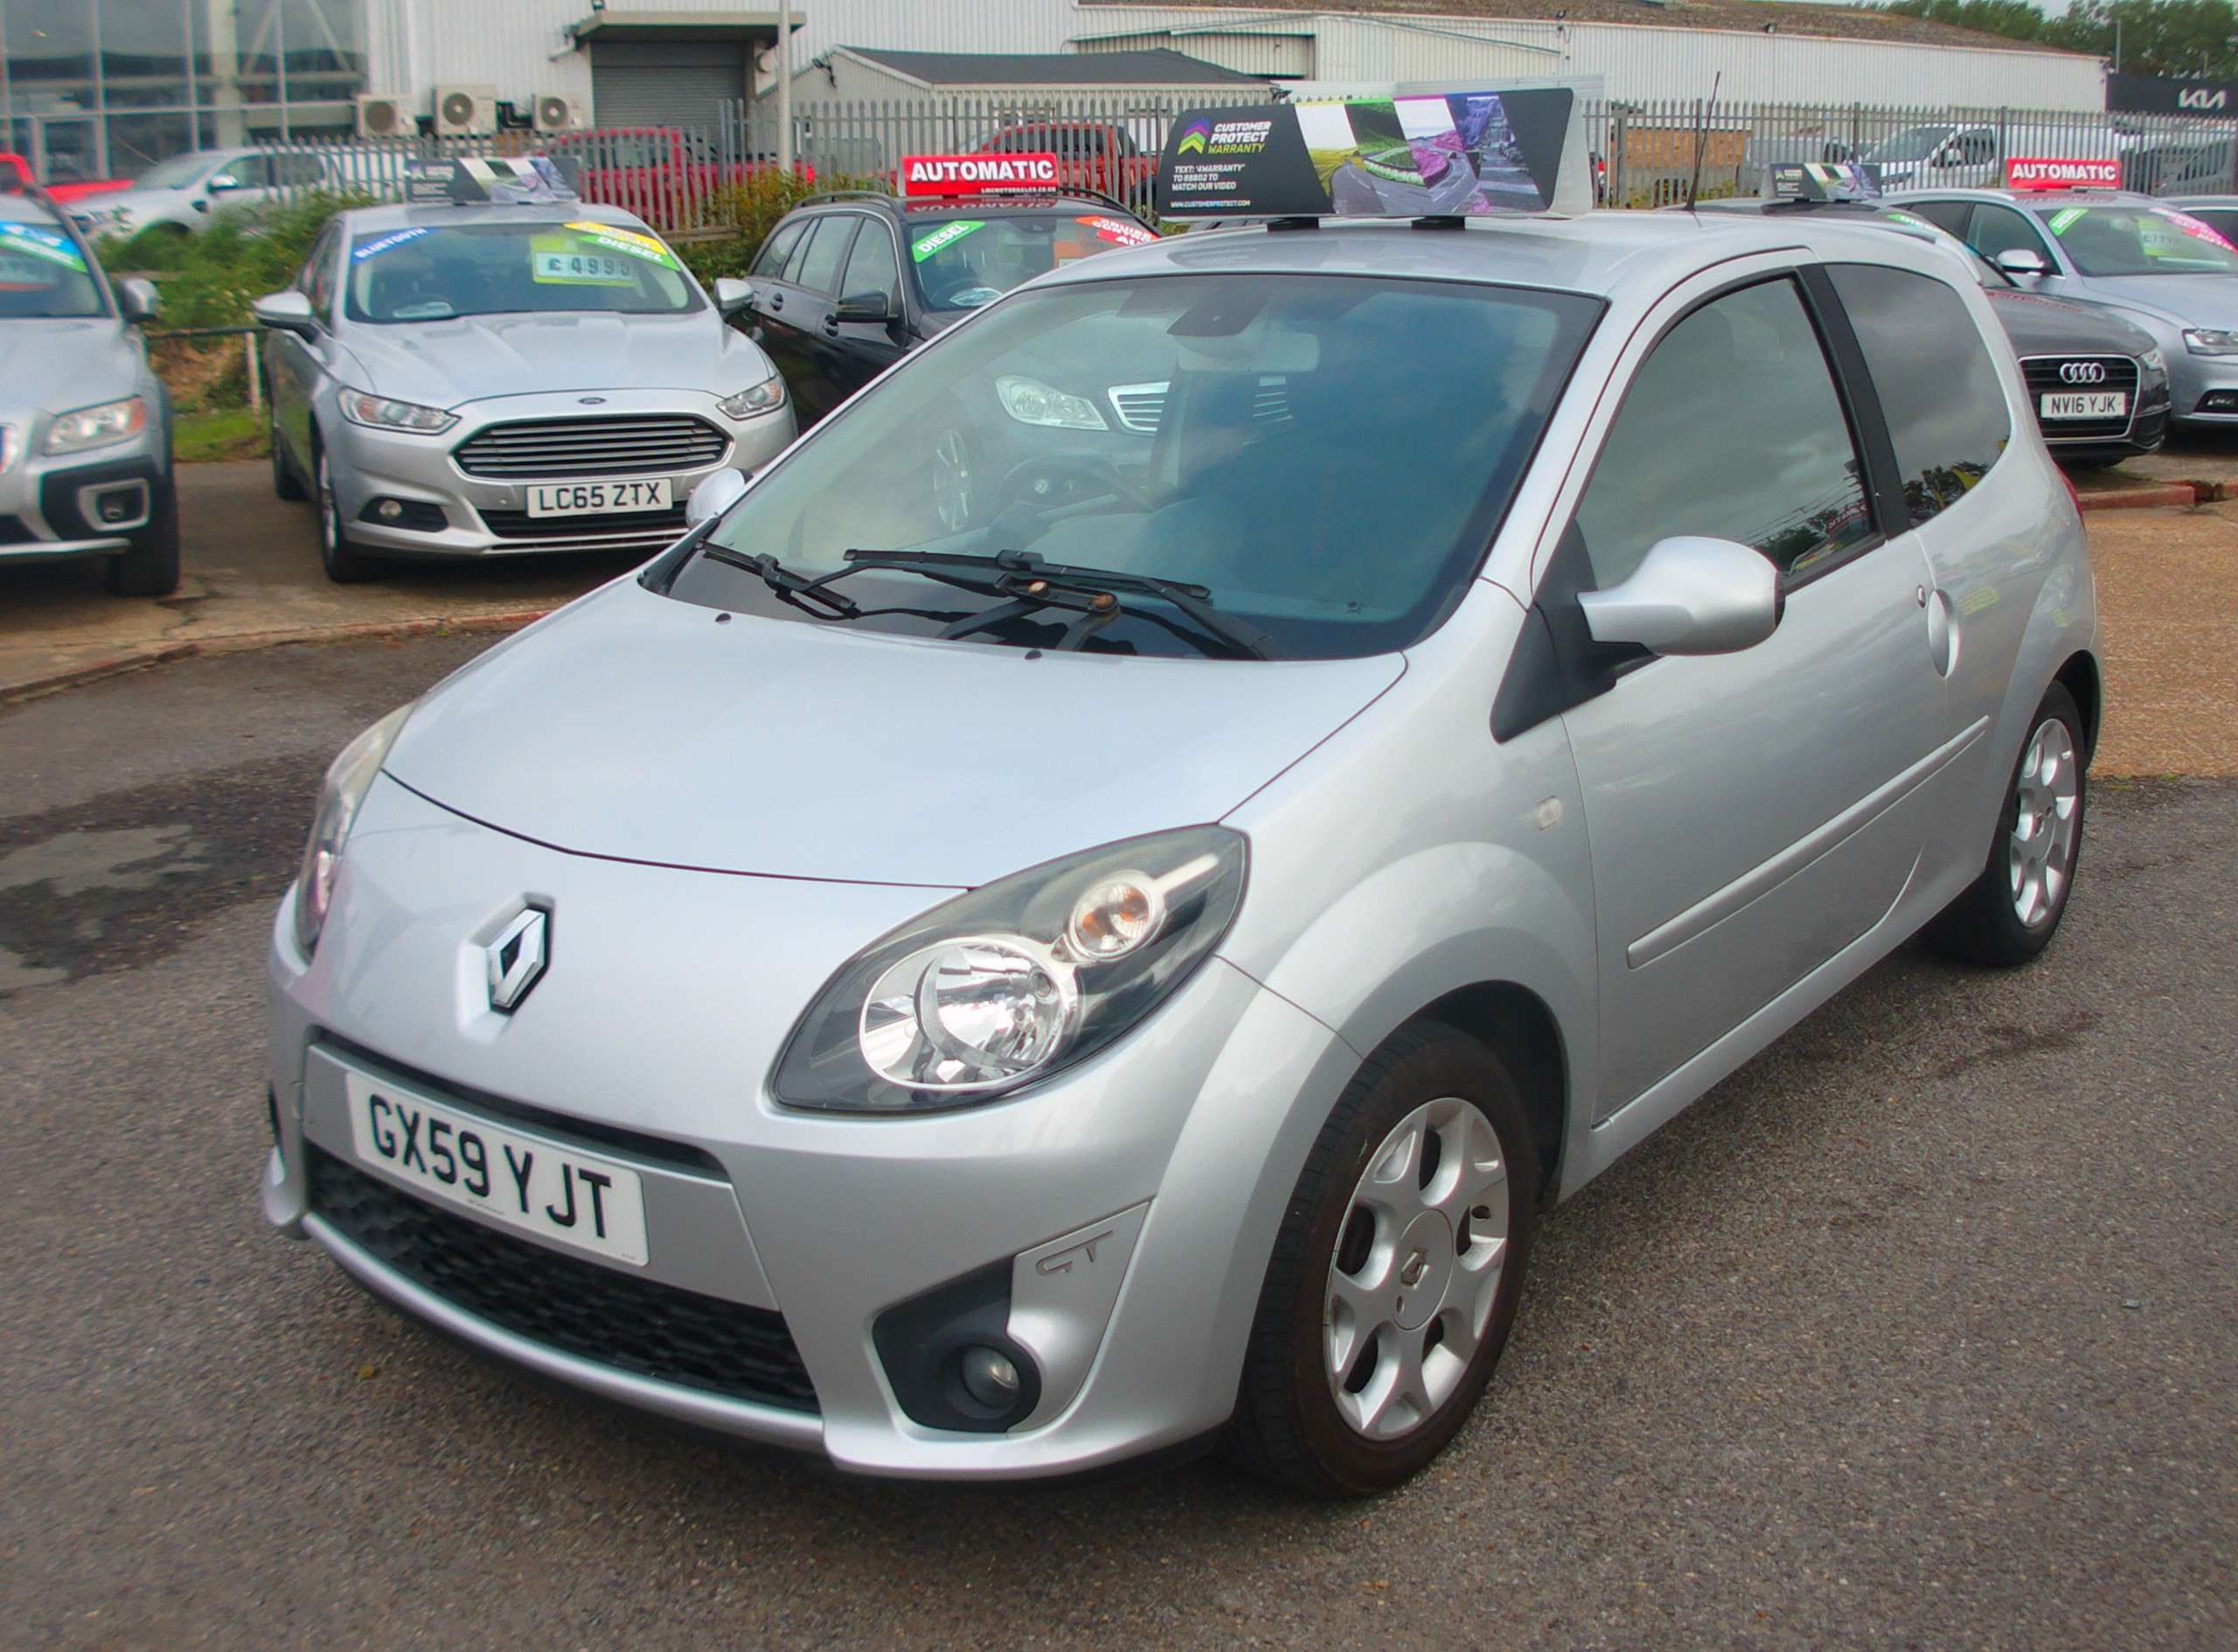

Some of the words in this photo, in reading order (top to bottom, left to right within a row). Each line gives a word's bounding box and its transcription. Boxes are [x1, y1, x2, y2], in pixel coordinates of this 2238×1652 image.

[1213, 121, 1271, 133] CUSTOMER
[1211, 131, 1268, 144] PROTECT
[1208, 142, 1265, 155] WARRANTY
[911, 160, 1054, 182] AUTOMATIC
[1173, 174, 1184, 183] TO
[2012, 163, 2116, 181] AUTOMATIC
[1214, 181, 1236, 190] VIDEO
[918, 224, 970, 253] DIESEL
[596, 236, 664, 262] DIESEL
[2051, 397, 2085, 414] NV16
[2089, 396, 2116, 413] YJK
[539, 486, 605, 511] LC65
[613, 482, 661, 507] ZTX
[369, 1093, 490, 1198] GX59
[504, 1144, 612, 1239] YJT
